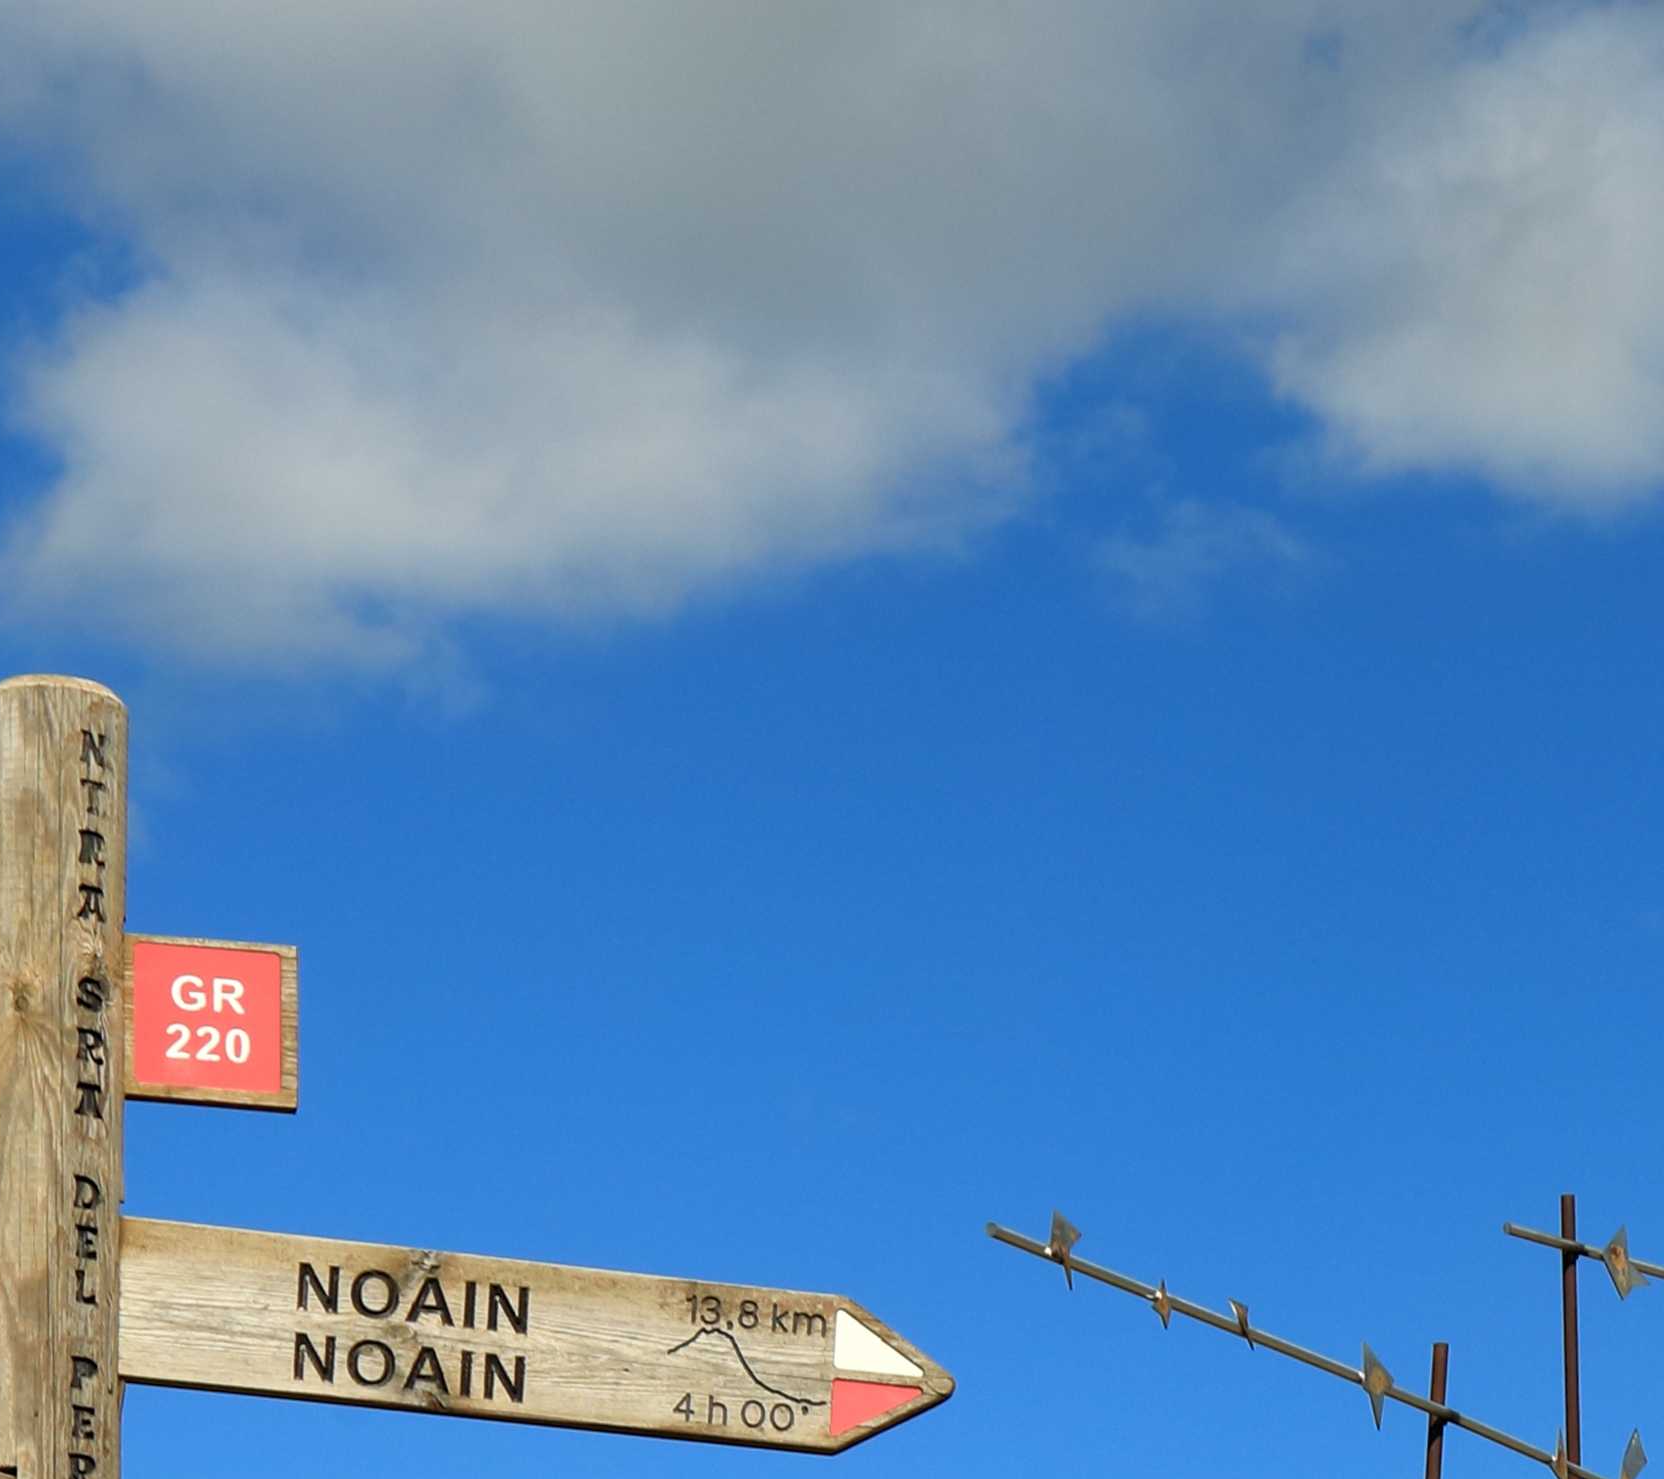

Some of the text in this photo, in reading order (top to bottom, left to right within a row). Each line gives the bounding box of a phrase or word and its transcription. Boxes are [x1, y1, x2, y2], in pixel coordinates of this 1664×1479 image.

[170, 974, 245, 1015] GR
[74, 975, 106, 1120] SRA
[164, 1023, 251, 1065] 220
[71, 1173, 100, 1305] DEL
[771, 1302, 827, 1339] km
[293, 1331, 527, 1404] NOAIN
